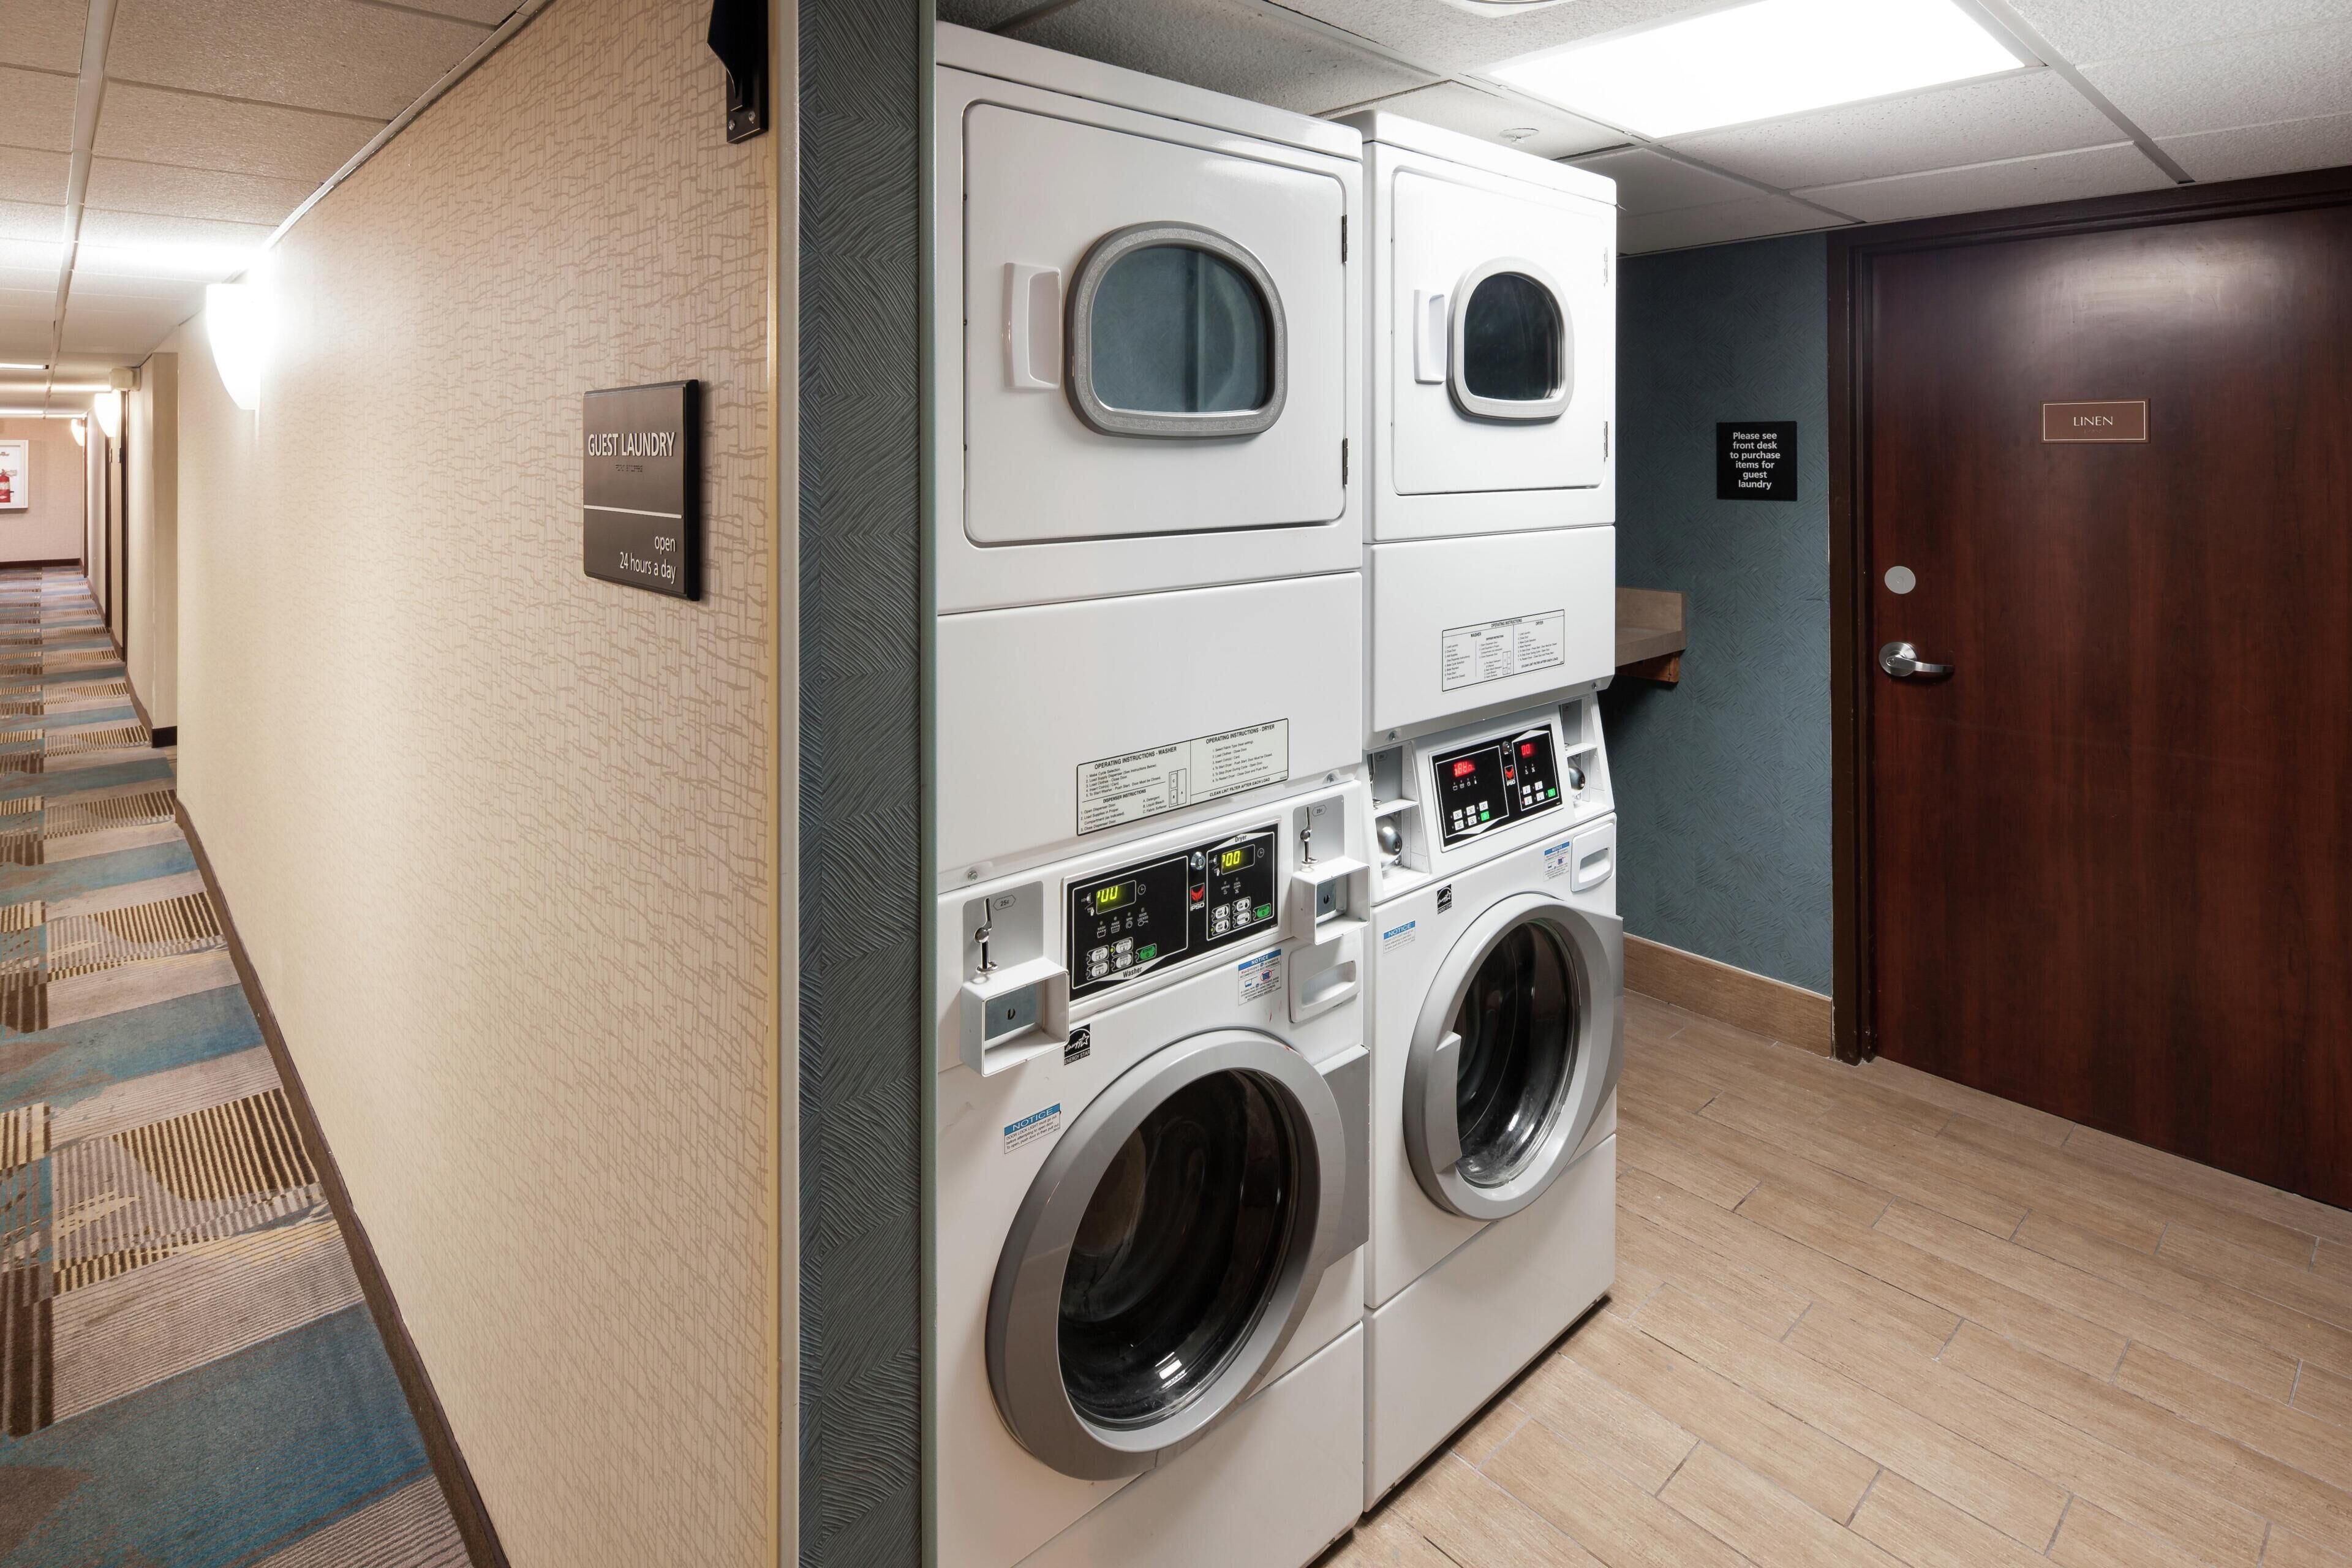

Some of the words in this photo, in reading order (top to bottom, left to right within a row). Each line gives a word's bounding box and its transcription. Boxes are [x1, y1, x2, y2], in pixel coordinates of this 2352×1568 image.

[2073, 416, 2113, 427] LINEN
[588, 432, 619, 457] GUEST
[621, 431, 675, 458] LAUNDRY
[1733, 441, 1755, 450] front
[1757, 441, 1777, 450] desk
[1741, 451, 1781, 461] purchase
[1743, 471, 1768, 480] guest
[1738, 480, 1772, 490] laundry
[654, 536, 676, 554] open
[619, 552, 629, 569] 24
[630, 552, 652, 575] hours
[654, 564, 658, 576] a
[661, 560, 676, 584] day
[1206, 733, 1229, 744] OPERATING
[1230, 728, 1259, 738] INSTRUCTIONS
[1095, 759, 1121, 769] OPERATING
[1122, 751, 1155, 763] INSTRUCTIONS
[1158, 746, 1177, 755] WASHER
[1102, 794, 1122, 803] DISPENSER
[1123, 789, 1147, 798] INSTRUCTIONS
[1190, 902, 1205, 911] IPSO
[1388, 922, 1412, 937] NOTICE
[1251, 955, 1269, 965] NOTICE
[1123, 967, 1142, 978] Washer
[1065, 1054, 1080, 1065] ENERGY
[1080, 1050, 1090, 1058] STAR
[1012, 1107, 1054, 1131] NOTICE
[1017, 1130, 1033, 1140] attempting
